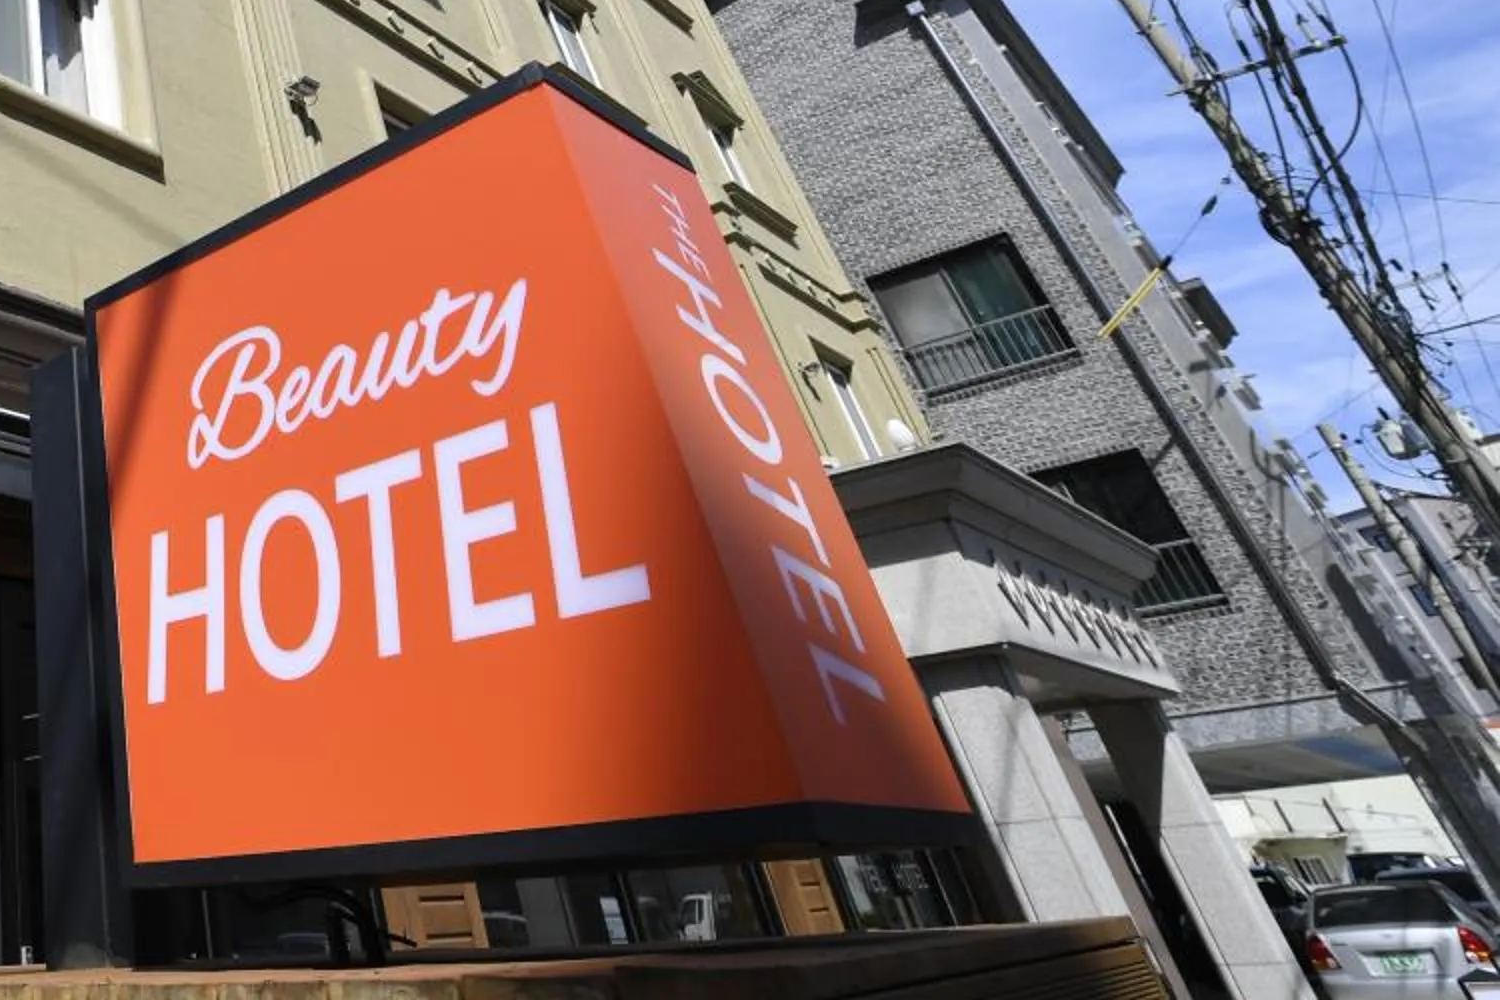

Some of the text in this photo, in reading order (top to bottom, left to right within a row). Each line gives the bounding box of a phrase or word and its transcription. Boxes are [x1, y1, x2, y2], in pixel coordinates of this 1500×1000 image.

[187, 278, 527, 469] Beauty
[650, 182, 886, 726] THE HOTEL
[147, 401, 651, 705] HOTEL
